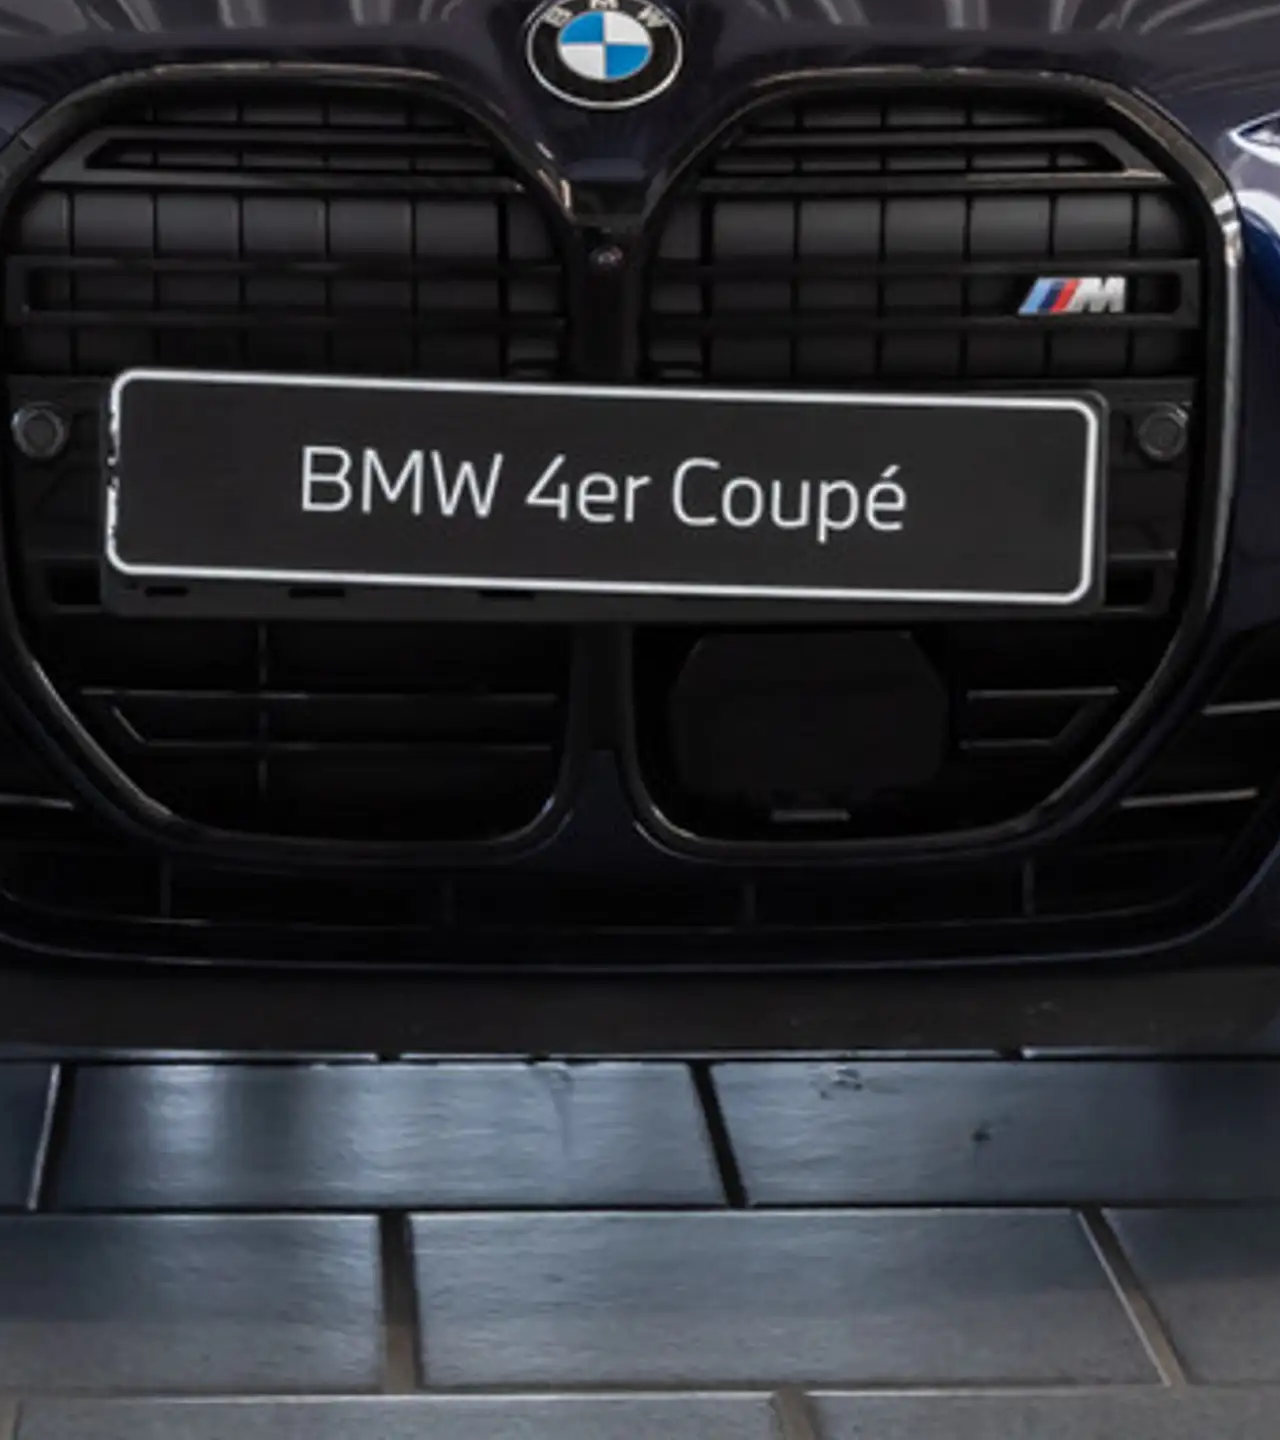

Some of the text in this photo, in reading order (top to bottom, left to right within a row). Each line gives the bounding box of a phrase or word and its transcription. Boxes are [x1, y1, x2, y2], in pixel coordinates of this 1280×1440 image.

[300, 445, 908, 544] BMW 4er Coupé
